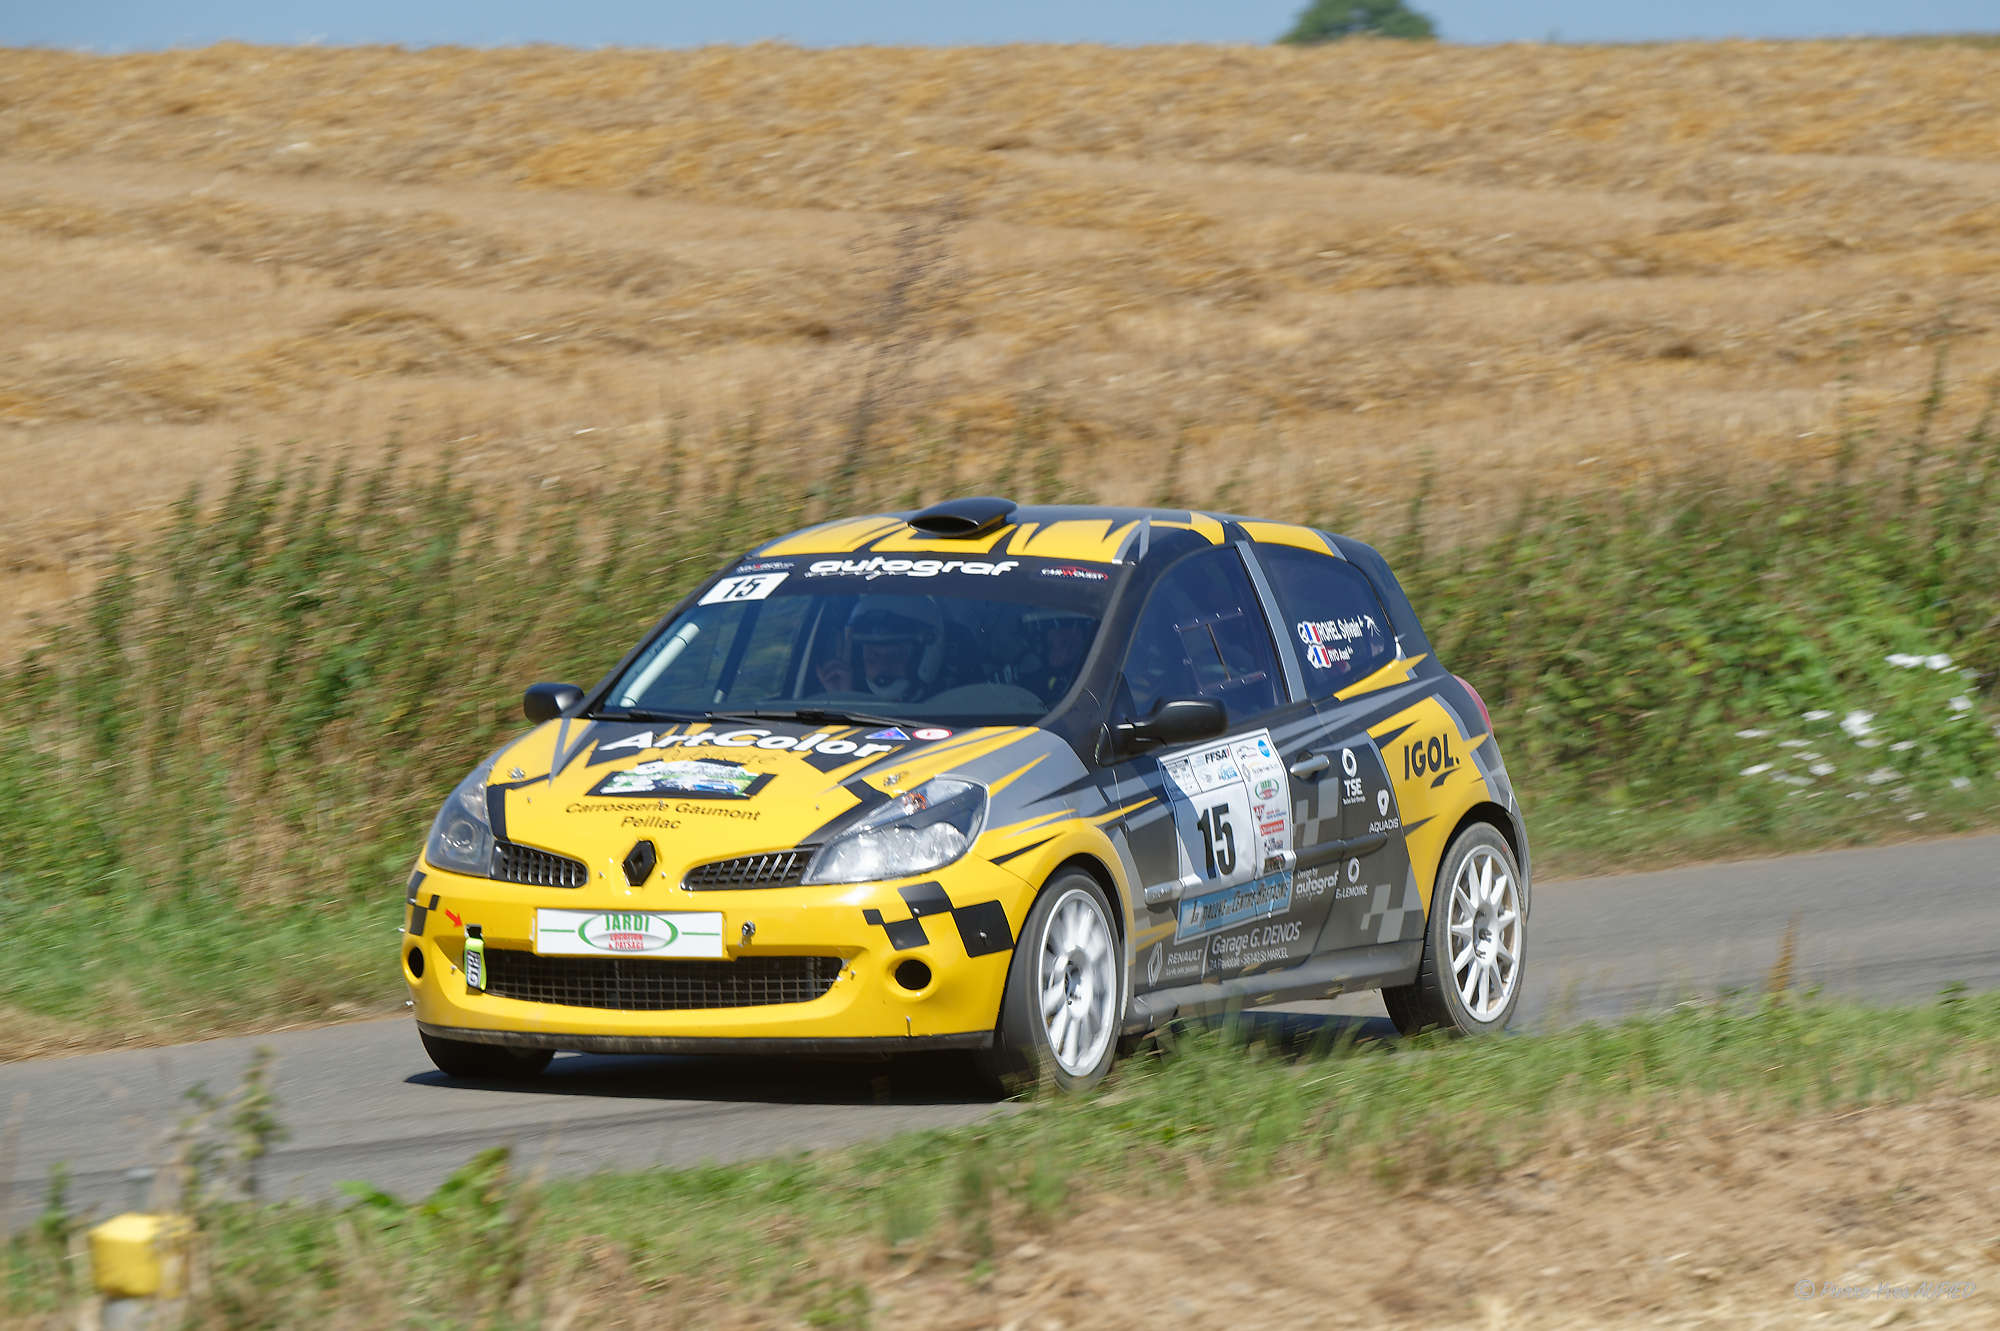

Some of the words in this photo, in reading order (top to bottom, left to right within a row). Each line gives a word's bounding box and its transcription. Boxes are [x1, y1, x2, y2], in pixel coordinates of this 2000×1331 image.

[809, 555, 1019, 581] autograf
[722, 576, 766, 598] 15
[599, 729, 892, 758] ArtColor
[1204, 748, 1229, 764] FFSA
[1344, 778, 1363, 797] TSE
[565, 802, 669, 814] Carrosserie
[675, 802, 761, 821] Gaumont
[621, 815, 682, 829] Peillac
[1368, 817, 1399, 834] AQUADIS
[1197, 801, 1235, 879] 15
[1296, 870, 1339, 896] autograf
[1342, 884, 1368, 898] LEMOINE
[605, 914, 649, 932] JARDI
[1212, 934, 1248, 956] Garage
[1250, 928, 1261, 948] G.
[1262, 921, 1302, 945] DENOS
[1167, 948, 1203, 966] RENAULT
